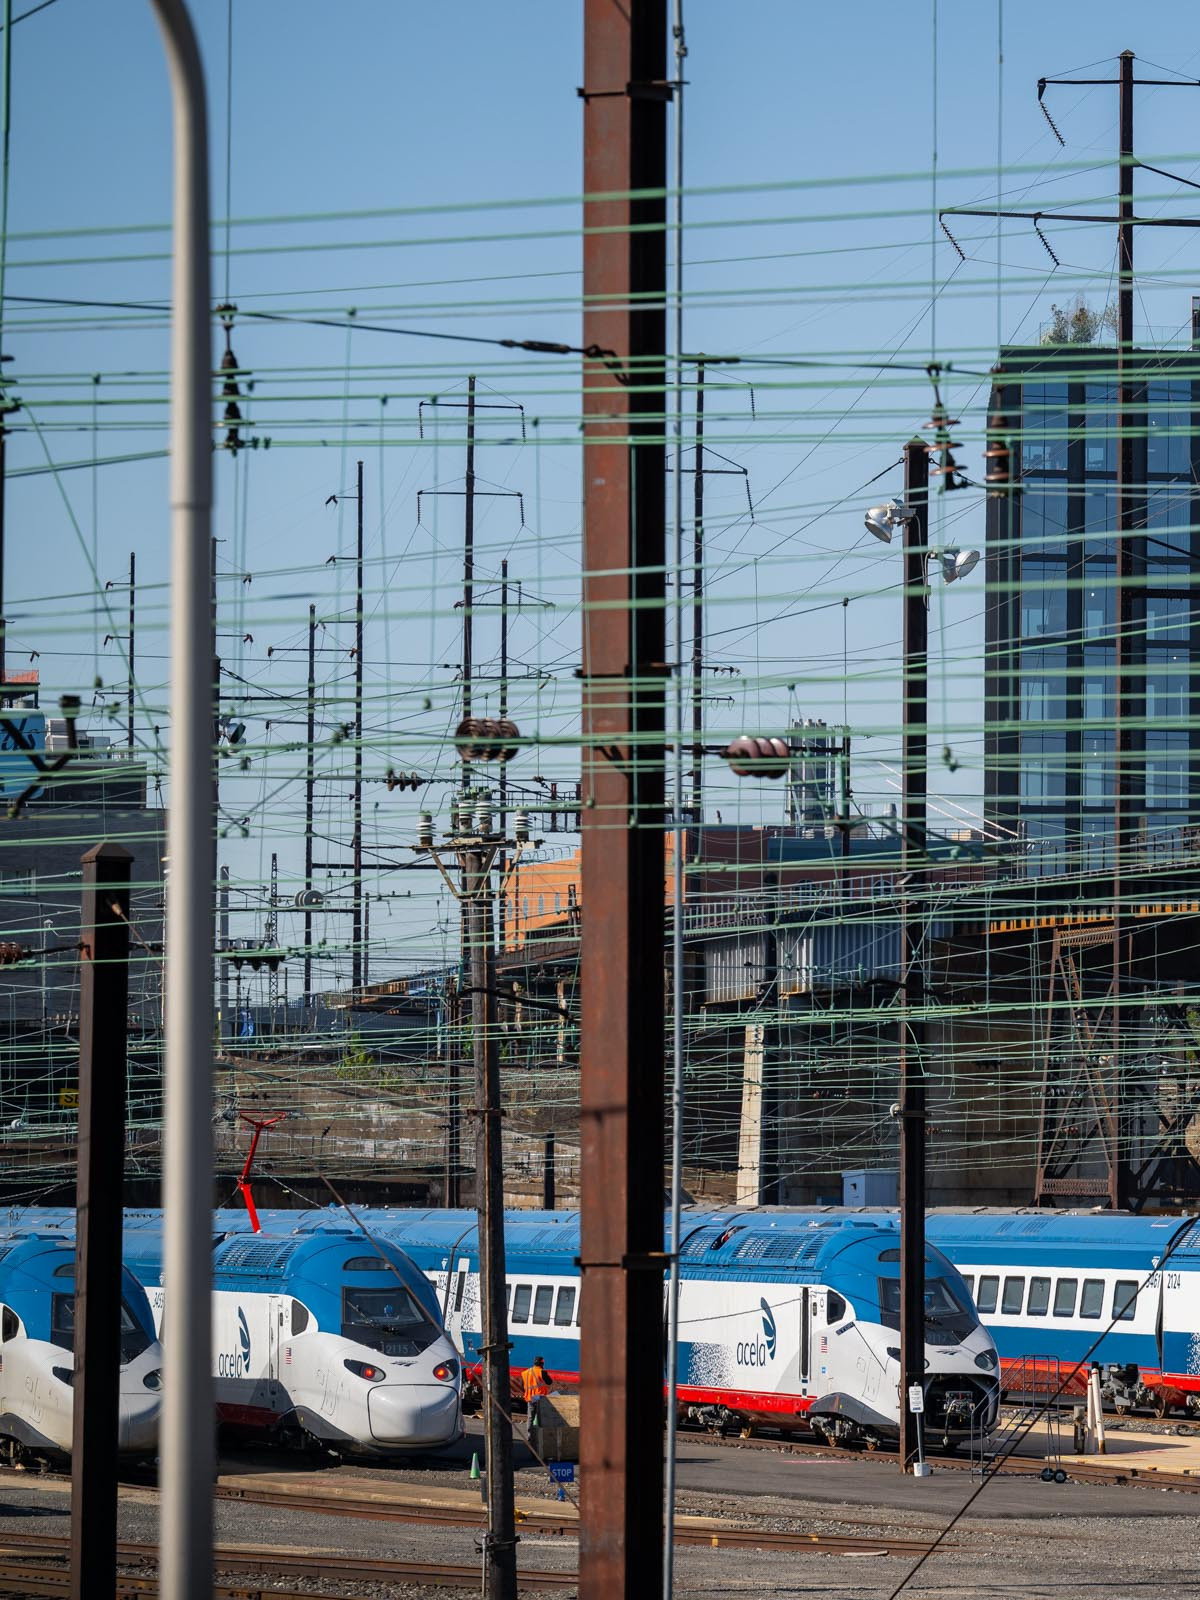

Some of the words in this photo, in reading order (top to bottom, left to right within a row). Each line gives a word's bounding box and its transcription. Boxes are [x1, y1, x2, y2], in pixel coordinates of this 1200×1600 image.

[1167, 1273, 1181, 1289] 2124
[385, 1344, 409, 1354] 2115
[736, 1333, 766, 1367] acela
[218, 1344, 243, 1379] acela
[551, 1468, 573, 1478] STOP
